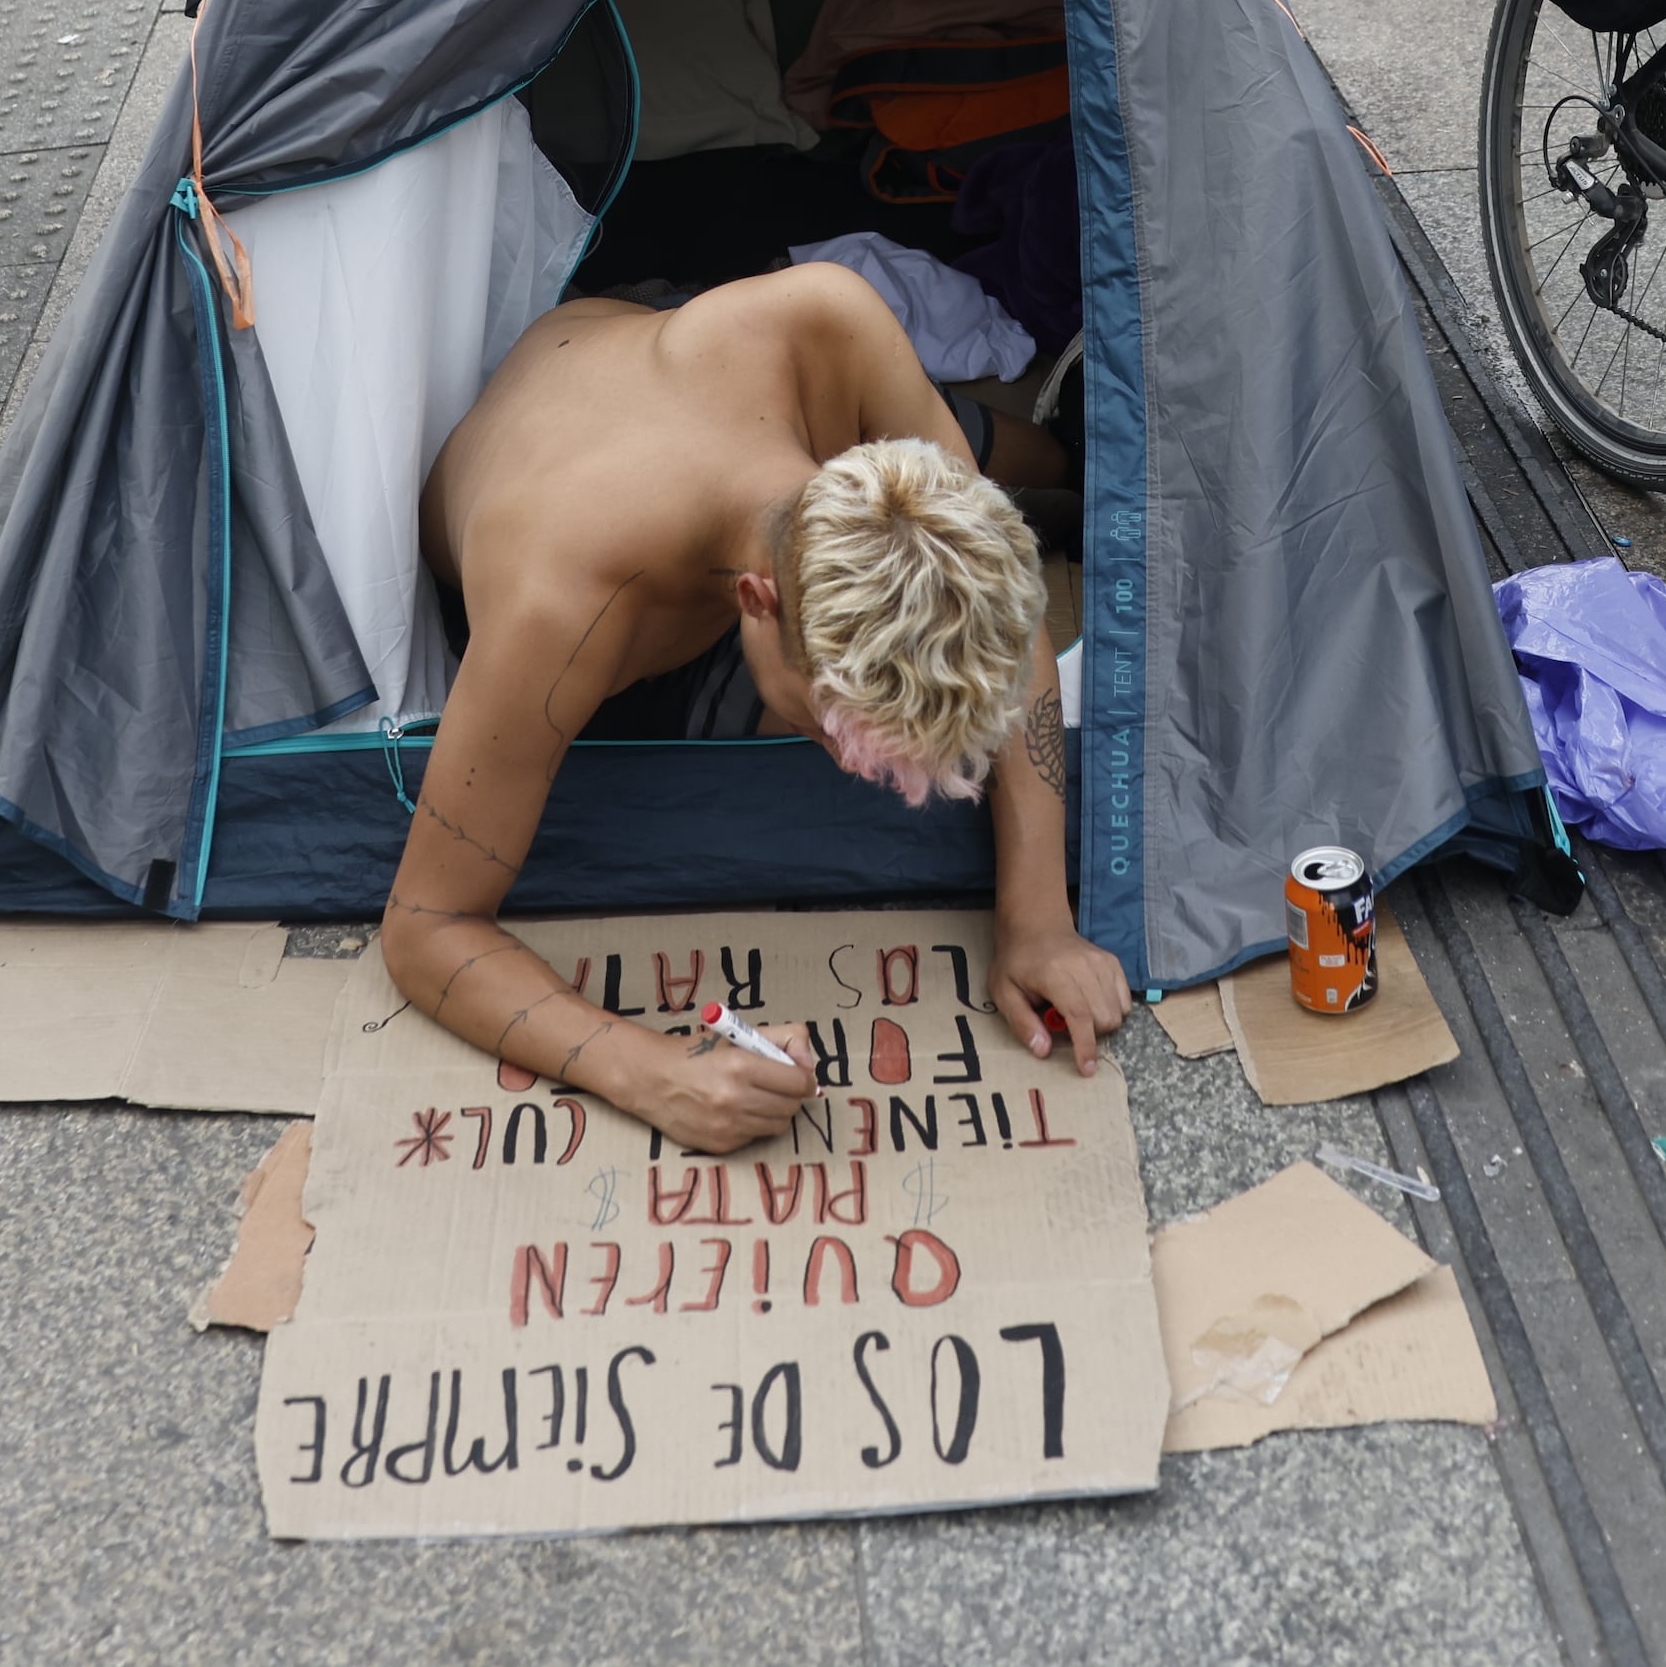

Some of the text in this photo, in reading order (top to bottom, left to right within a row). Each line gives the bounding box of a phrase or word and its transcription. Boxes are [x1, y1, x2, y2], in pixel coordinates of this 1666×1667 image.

[1110, 578, 1133, 877] QUECHUA TENT 100
[589, 943, 998, 1017] LOS RAT
[647, 1159, 868, 1226] PLATA
[709, 1361, 801, 1472] DE
[851, 1321, 1065, 1468] LOS
